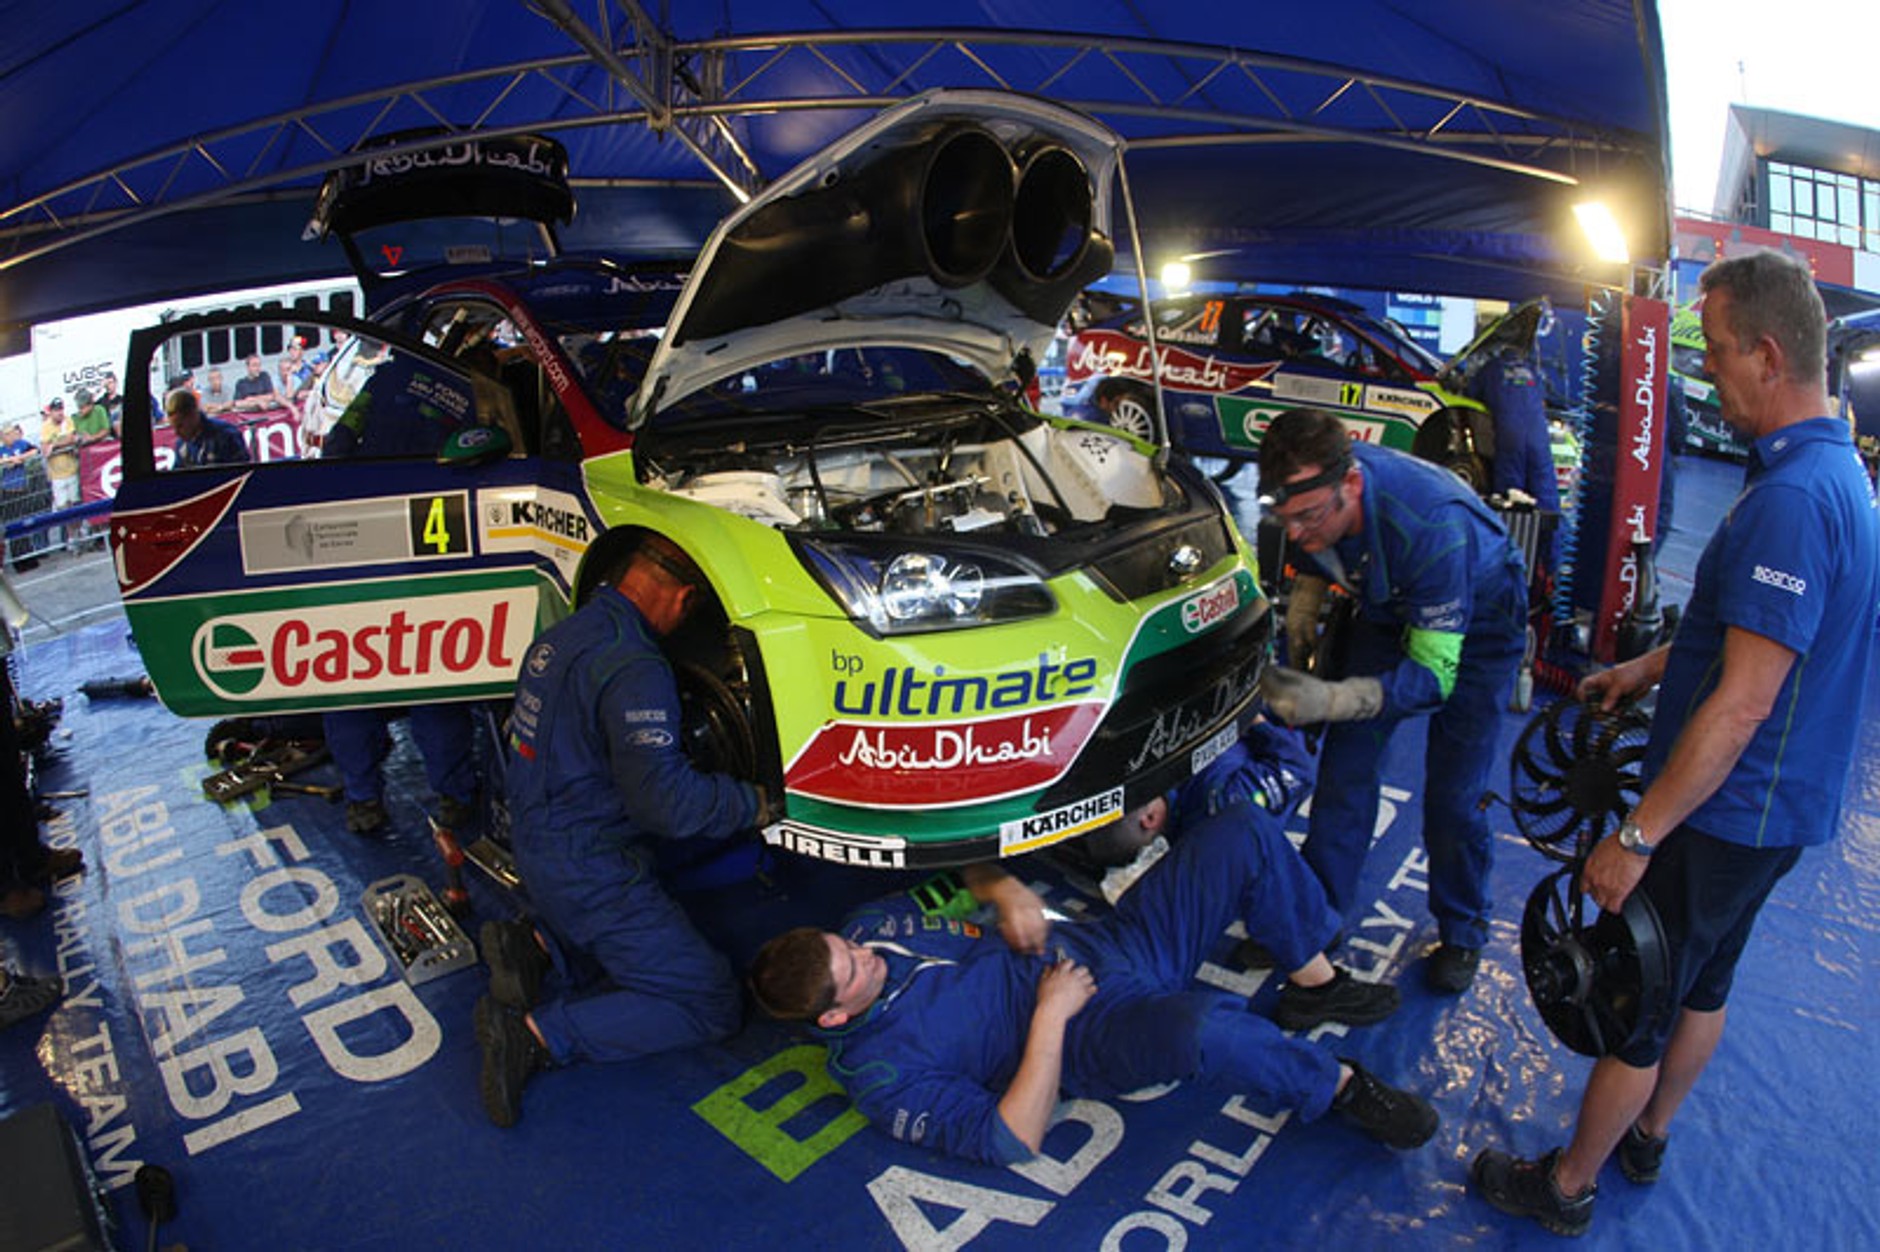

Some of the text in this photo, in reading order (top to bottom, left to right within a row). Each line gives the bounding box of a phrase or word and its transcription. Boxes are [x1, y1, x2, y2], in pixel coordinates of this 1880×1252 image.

[1199, 301, 1224, 333] 17
[1341, 384, 1361, 405] 17
[423, 497, 451, 554] 4
[1198, 578, 1237, 624] Castrol
[1751, 565, 1806, 596] sparco
[271, 601, 513, 688] Castrol
[832, 649, 863, 676] bp
[833, 652, 1097, 716] ultimate
[96, 784, 184, 877] ABU
[1021, 792, 1122, 840] KÄRCHER
[52, 897, 104, 1010] RALLY
[214, 823, 443, 1083] FORD
[117, 877, 303, 1156] DHABI
[69, 1020, 145, 1190] TEAM
